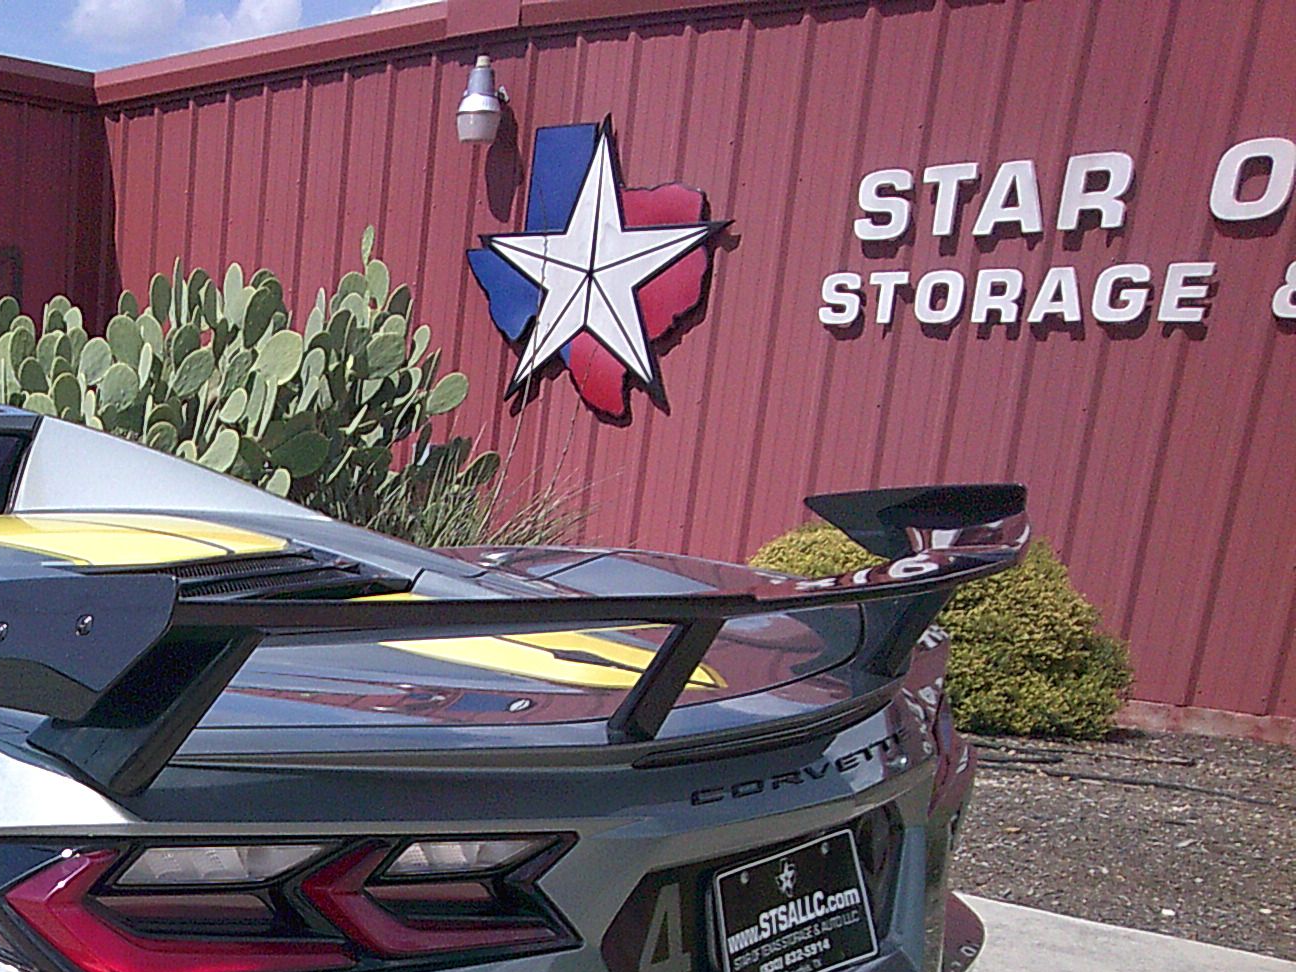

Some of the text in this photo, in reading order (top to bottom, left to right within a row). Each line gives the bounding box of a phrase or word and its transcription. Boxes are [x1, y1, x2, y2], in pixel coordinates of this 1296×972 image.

[854, 151, 1134, 241] STAR
[818, 262, 1216, 326] STORAGE
[727, 888, 861, 953] www.STSALLC.com
